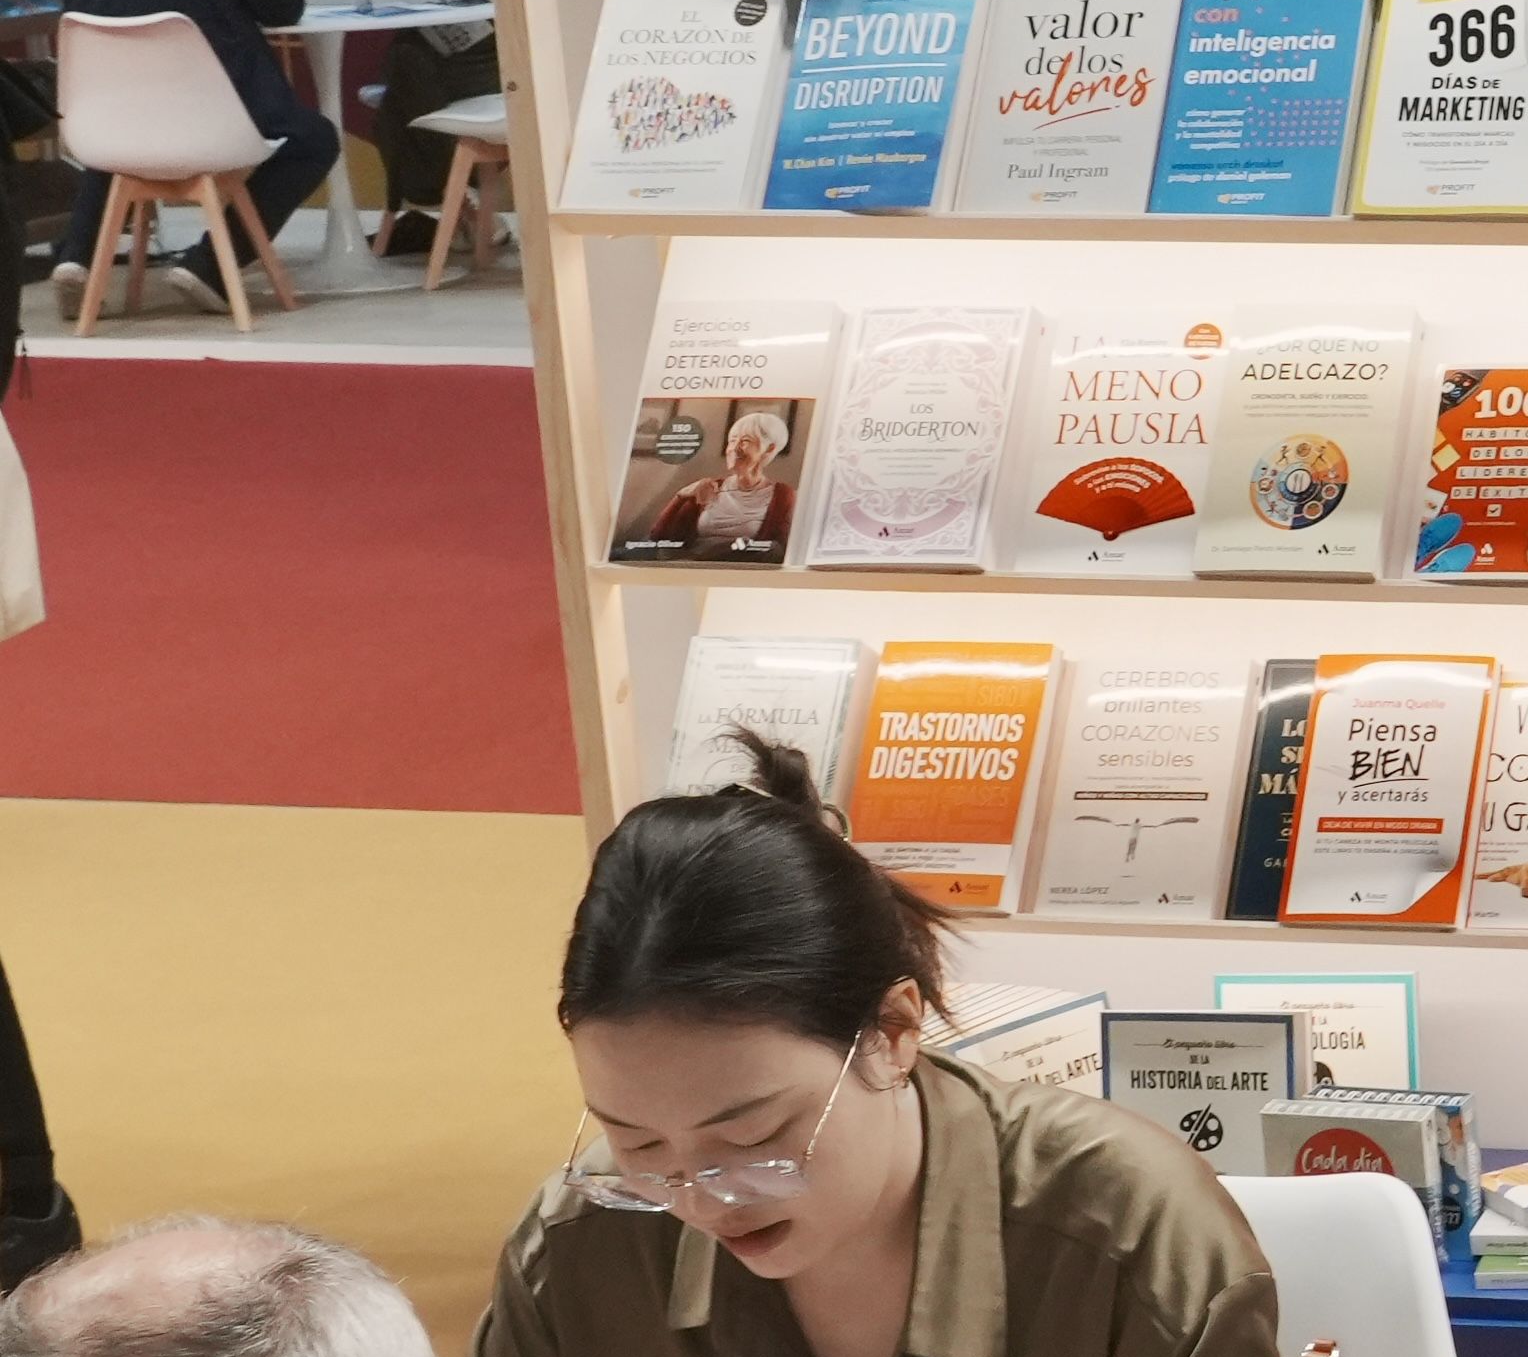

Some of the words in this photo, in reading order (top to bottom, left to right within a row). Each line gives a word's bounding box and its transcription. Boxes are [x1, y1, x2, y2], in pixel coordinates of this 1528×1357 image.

[1025, 0, 1144, 41] valor
[1194, 6, 1239, 24] con
[804, 12, 957, 61] BEYOND
[1189, 29, 1336, 57] inteligencia
[1428, 4, 1517, 67] 366
[643, 50, 757, 65] NEGOCIOS
[1025, 48, 1063, 76] de
[1077, 44, 1123, 75] los
[999, 53, 1155, 115] valores
[1183, 59, 1317, 86] emocional
[1431, 74, 1477, 91] DÍAS
[1482, 78, 1501, 89] DE
[793, 76, 943, 111] DISRUPTION
[1398, 95, 1526, 122] MARKETING
[1007, 161, 1043, 179] Paul
[1048, 162, 1108, 182] Ingram
[664, 355, 768, 369] DETERIORO
[1241, 363, 1389, 380] ADELGAZO?
[660, 376, 762, 390] COGNITIVO
[1061, 370, 1203, 402] MENO
[910, 404, 933, 414] LOS
[860, 418, 980, 441] BRIDGERTON
[1054, 412, 1208, 444] PAUSIA
[879, 712, 1025, 742] TRASTORNOS
[1348, 718, 1437, 742] Piensa
[868, 746, 1018, 780] DIGESTIVOS
[1349, 745, 1424, 780] BIEN
[1351, 788, 1428, 802] acertarás
[1131, 1070, 1202, 1089] HISTORIA
[1206, 1076, 1228, 1090] DEL
[1231, 1072, 1269, 1091] ARTE
